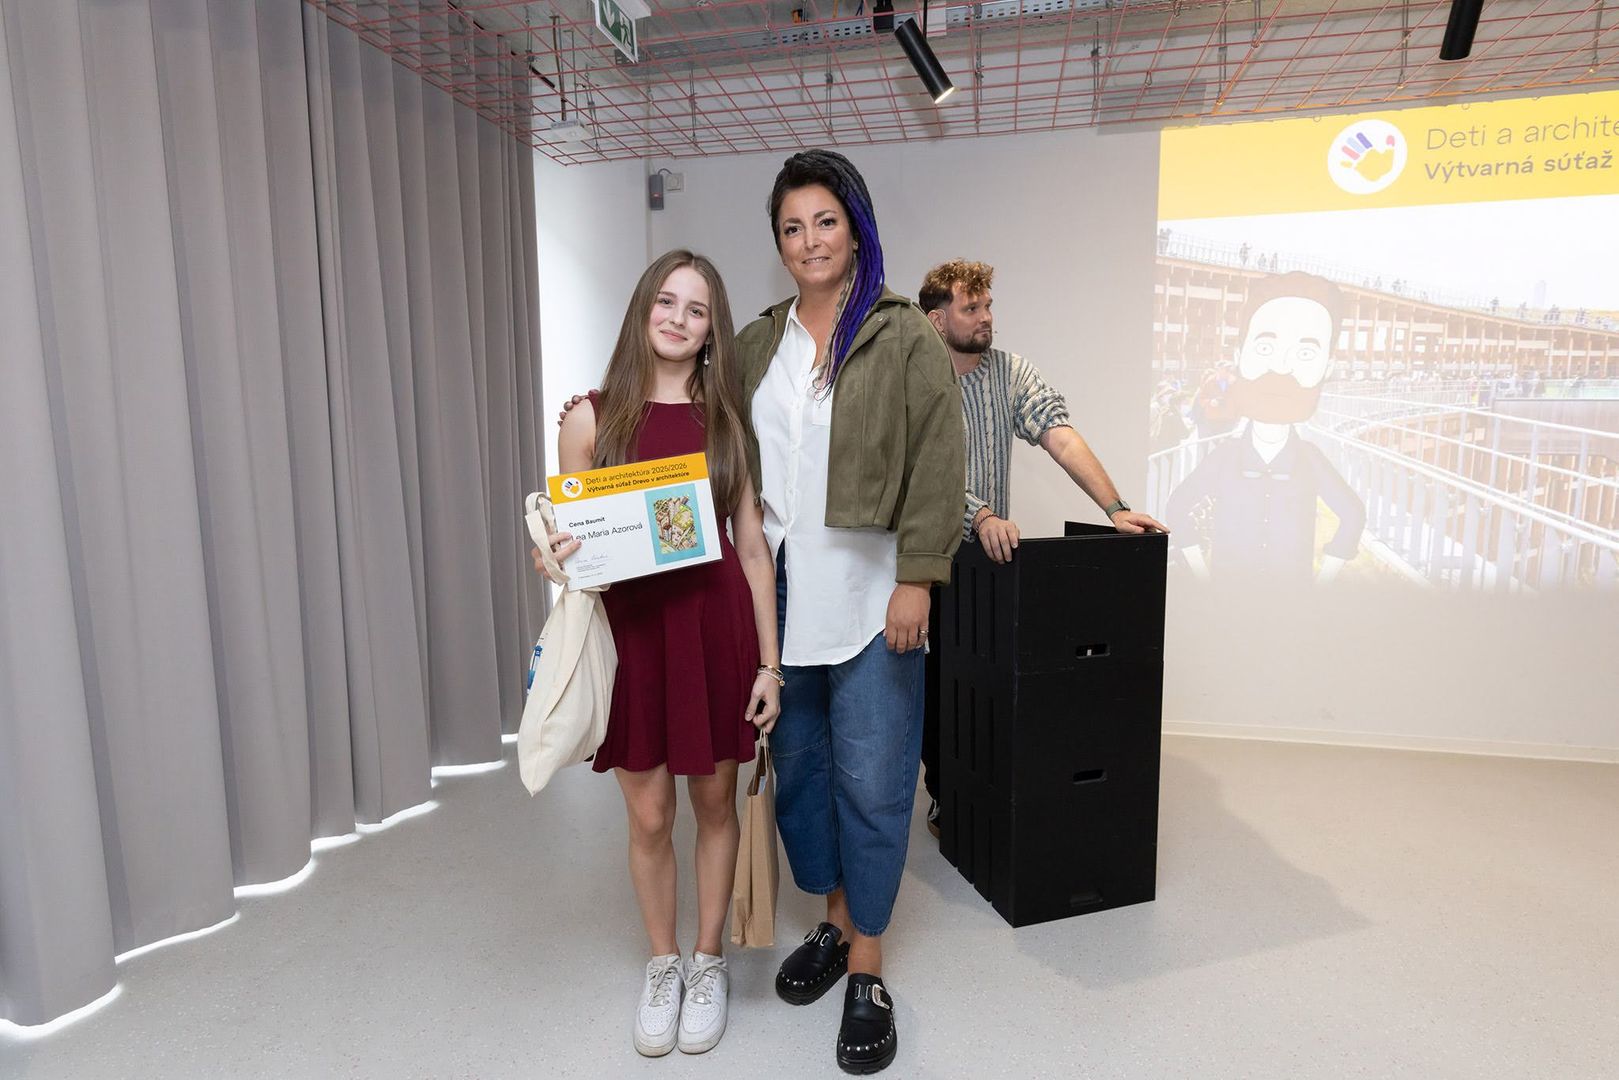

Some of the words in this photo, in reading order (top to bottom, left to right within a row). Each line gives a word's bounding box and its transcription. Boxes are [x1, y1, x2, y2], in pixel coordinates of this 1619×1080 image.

[1426, 124, 1487, 151] Deti
[1496, 127, 1513, 145] a
[1424, 155, 1534, 184] Výtvarná
[1543, 150, 1614, 172] súťaž
[585, 477, 601, 485] Deti
[609, 469, 650, 480] architektúra
[651, 463, 688, 474] 2025/2026
[587, 484, 614, 493] Výtvarná
[656, 471, 690, 481] architektúre
[585, 517, 606, 525] Baumit
[611, 522, 643, 534] Azorová
